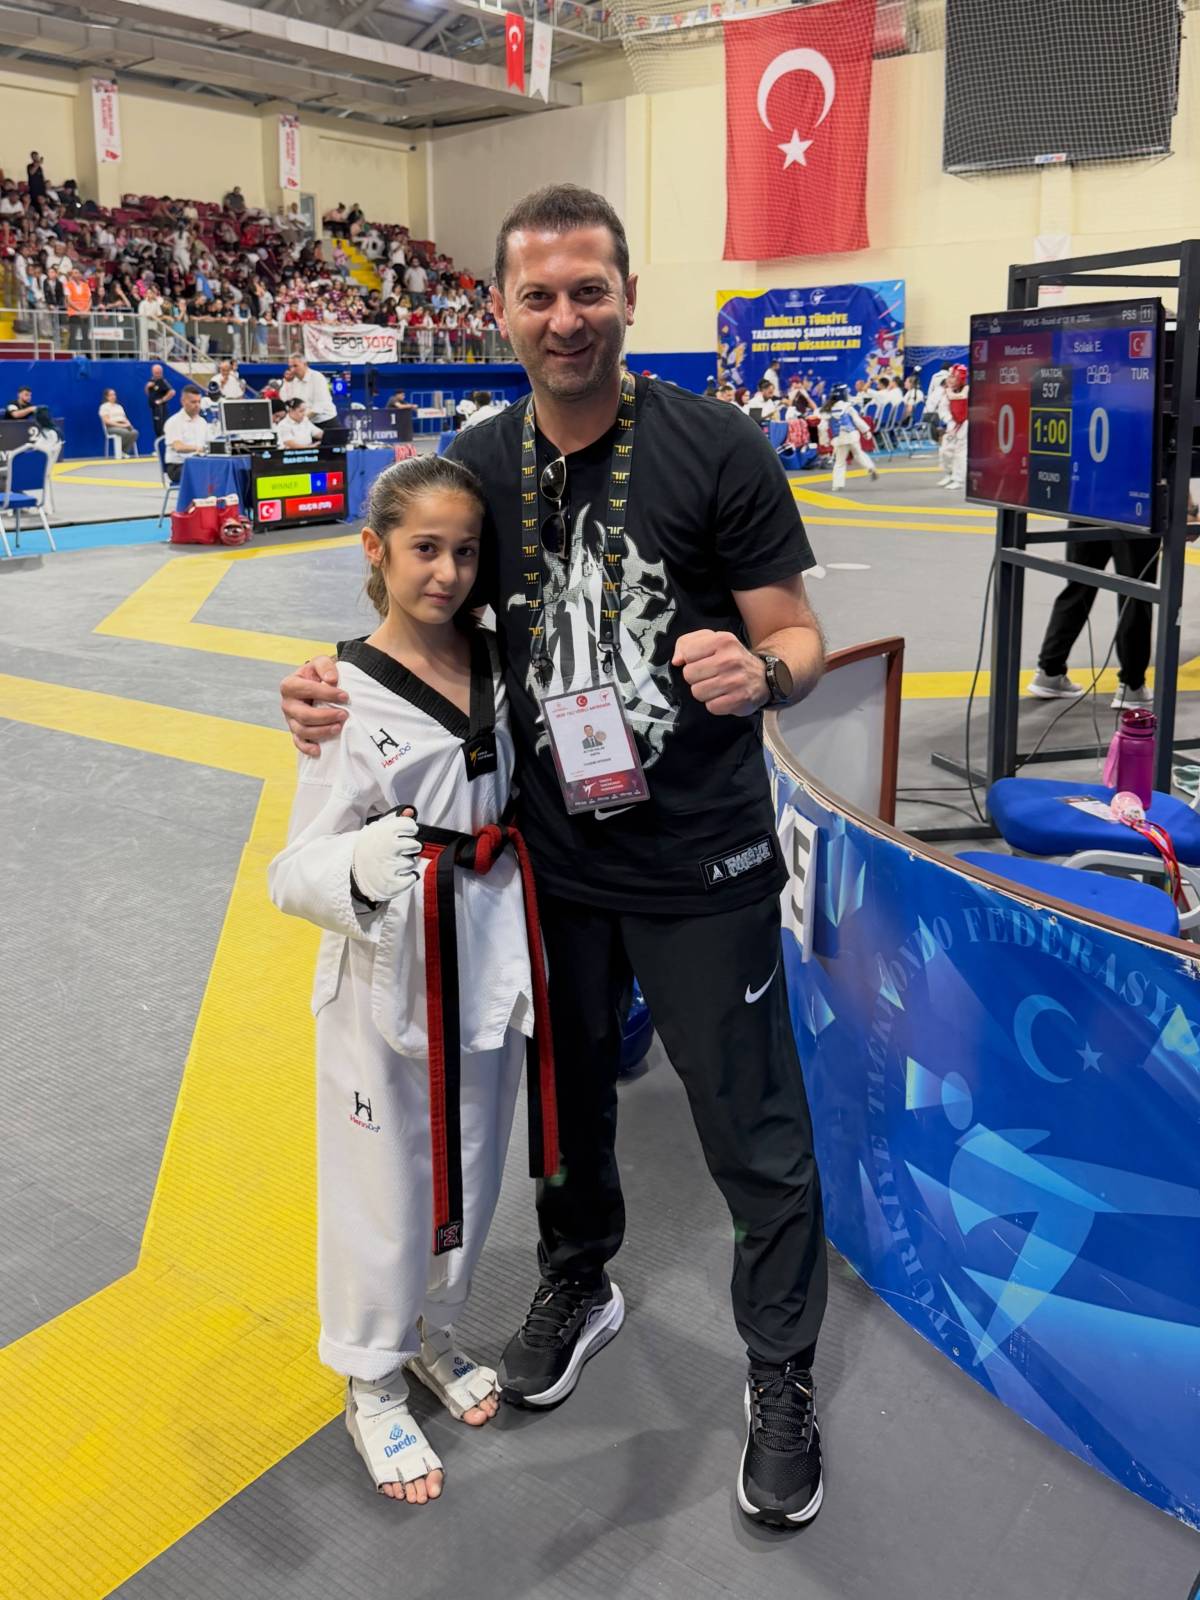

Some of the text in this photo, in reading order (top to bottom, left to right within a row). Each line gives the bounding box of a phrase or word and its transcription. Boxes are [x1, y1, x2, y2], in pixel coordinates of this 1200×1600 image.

[1131, 368, 1149, 380] TUR
[1042, 383, 1060, 398] 537
[998, 404, 1015, 454] 0
[1034, 418, 1067, 444] 1:00
[1089, 407, 1110, 463] 0
[1038, 470, 1060, 482] ROUND
[1135, 502, 1142, 517] 0
[383, 1432, 417, 1458] Daedo
